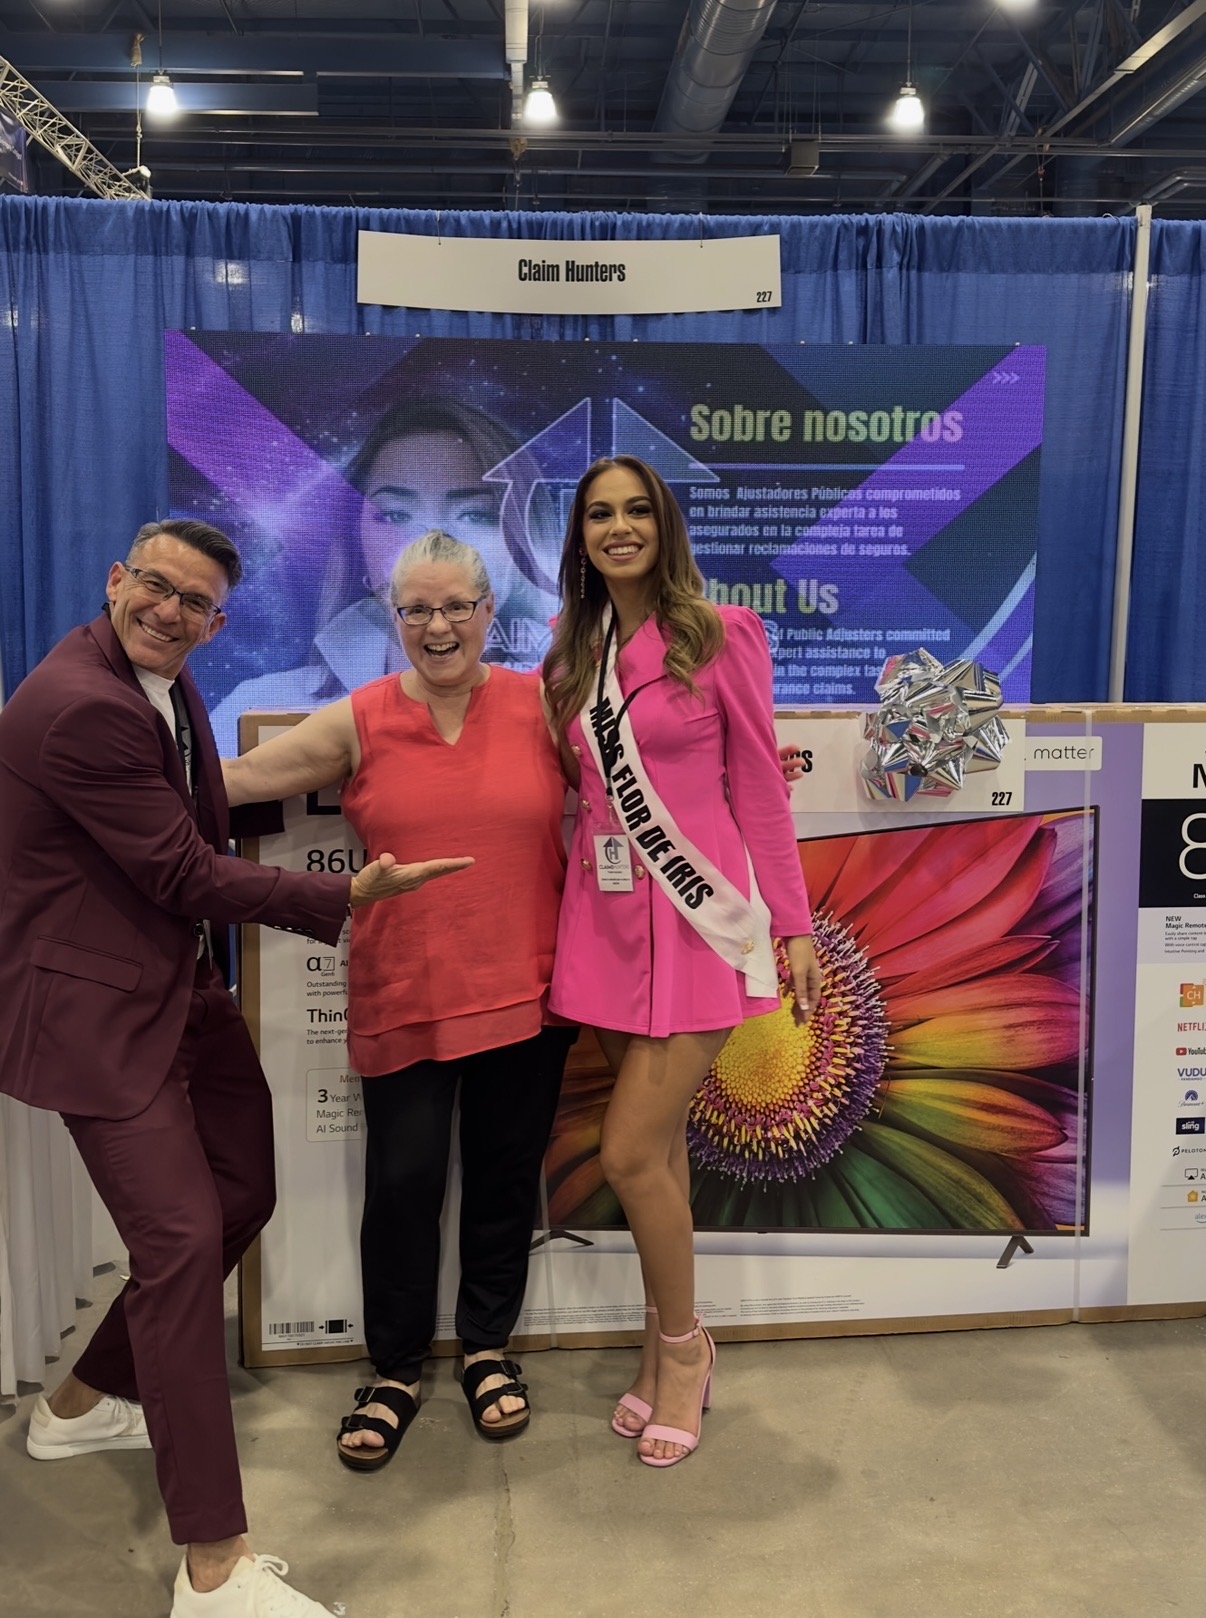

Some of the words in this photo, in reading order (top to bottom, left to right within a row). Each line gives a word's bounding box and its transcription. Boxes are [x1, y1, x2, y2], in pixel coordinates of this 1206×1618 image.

[518, 259, 560, 282] Claim
[565, 260, 626, 282] Hunters
[756, 291, 772, 303] 227
[690, 404, 792, 442] Sobre
[803, 406, 964, 443] nosotros
[689, 486, 730, 499] Somos
[736, 486, 808, 500] Ajustadores
[811, 485, 863, 500] Públicos
[866, 487, 960, 502] comprometidos
[689, 506, 704, 517] en
[707, 505, 750, 518] brindar
[753, 505, 816, 518] asistencia
[820, 506, 865, 520] experta
[868, 507, 876, 518] a
[879, 506, 898, 518] los
[689, 524, 759, 537] asegurados
[763, 525, 777, 536] en
[781, 524, 792, 536] la
[853, 525, 885, 537] tarea
[888, 525, 903, 537] de
[708, 578, 787, 613] bout
[798, 579, 839, 614] Us
[787, 627, 823, 641] Public
[826, 627, 883, 642] Adjusters
[886, 628, 951, 641] committed
[805, 646, 871, 659] assistance
[873, 646, 887, 659] to
[788, 663, 806, 677] the
[810, 663, 861, 678] complex
[864, 664, 882, 677] tas
[813, 681, 856, 695] claims.
[1033, 745, 1095, 760] matter
[991, 791, 1013, 806] 227
[611, 764, 652, 831] FLOR
[635, 825, 676, 862] DE
[659, 855, 714, 910] IRIS
[1165, 922, 1184, 930] Magic
[306, 981, 347, 990] Outstanding
[306, 989, 321, 997] with
[306, 1007, 348, 1023] Thin
[1178, 1022, 1206, 1032] NETFLI
[1178, 1067, 1206, 1077] VUDU
[317, 1088, 328, 1103] 3
[330, 1094, 350, 1103] Year
[316, 1109, 344, 1120] Magic
[329, 1123, 359, 1133] Sound
[1181, 1121, 1200, 1131] sling
